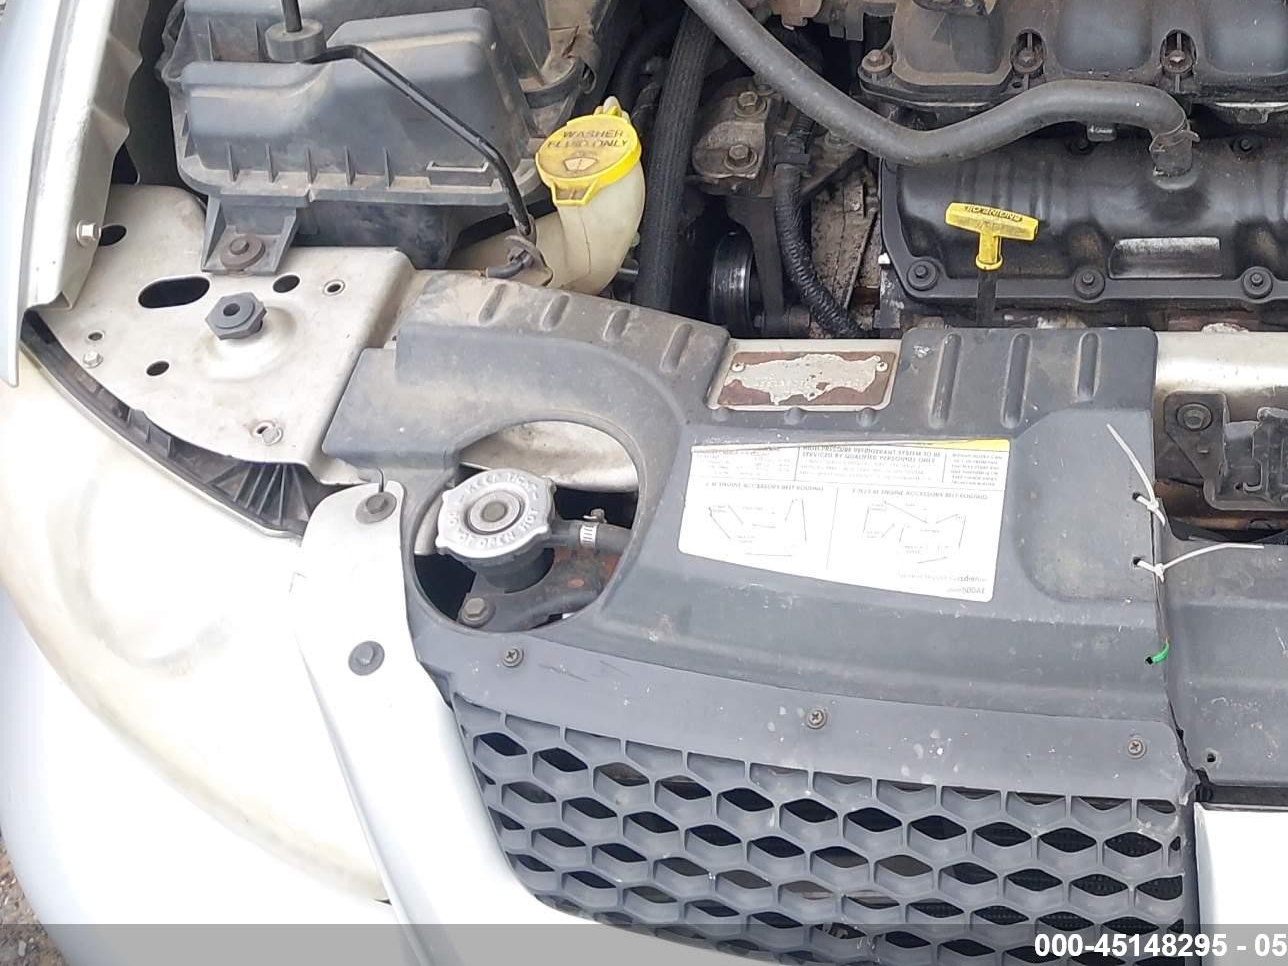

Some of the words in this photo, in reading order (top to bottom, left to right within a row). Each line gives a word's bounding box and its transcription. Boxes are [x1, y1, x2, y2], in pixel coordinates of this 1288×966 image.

[564, 130, 624, 138] WASHER
[547, 140, 590, 148] FLUID
[592, 138, 628, 147] ONLY
